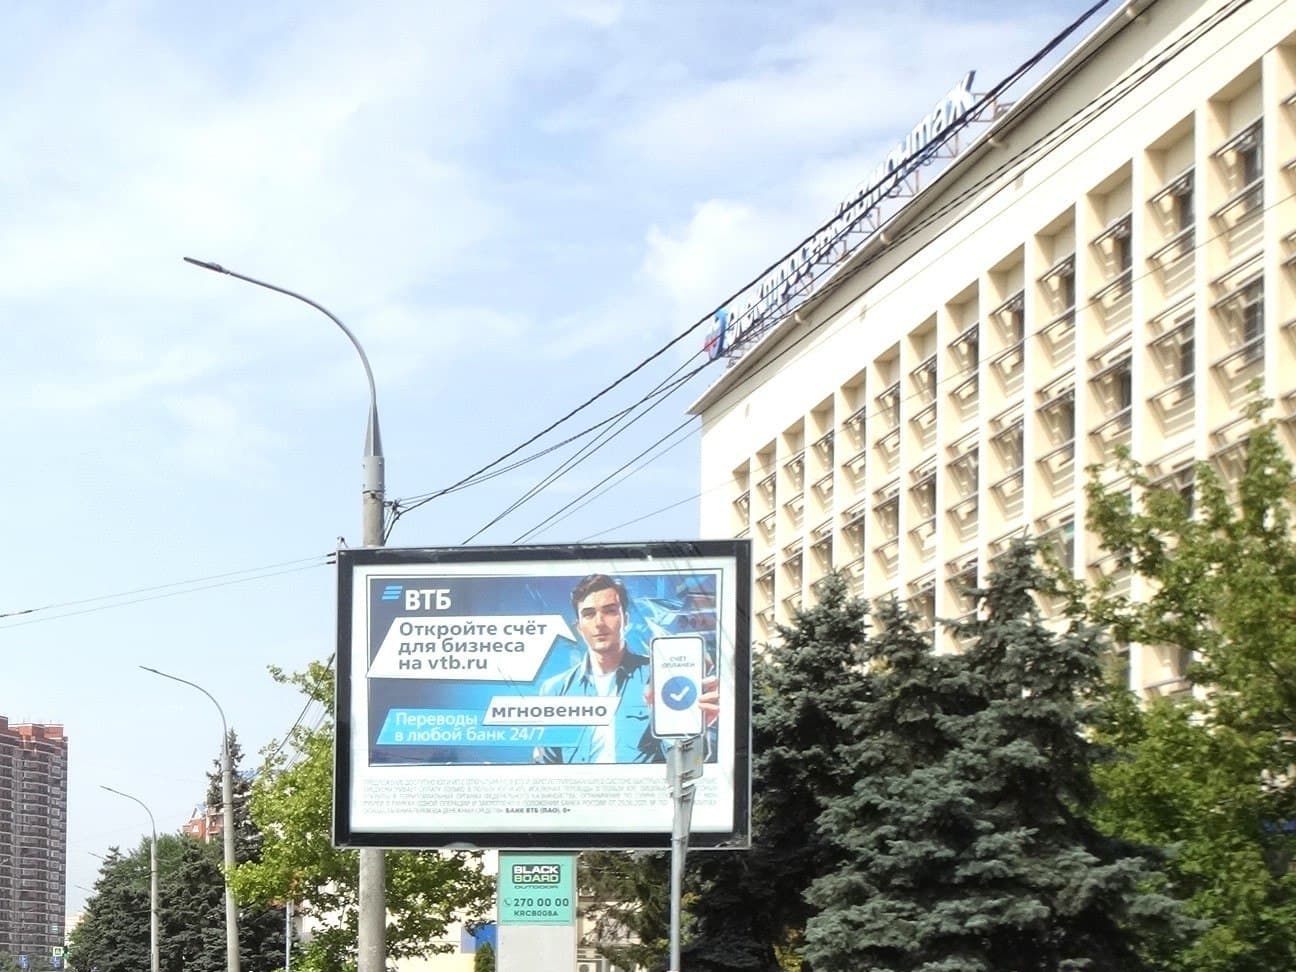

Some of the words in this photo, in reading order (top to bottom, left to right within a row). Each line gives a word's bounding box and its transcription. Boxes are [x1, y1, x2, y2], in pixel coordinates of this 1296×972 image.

[405, 588, 452, 611] ВТБ
[398, 621, 498, 638] Откройте
[503, 622, 547, 636] счёт
[398, 640, 435, 654] для
[442, 638, 525, 654] бизнеса
[398, 657, 422, 670] на
[428, 654, 488, 670] vtb.ru
[396, 712, 478, 728] Переводы
[491, 705, 607, 719] мгновенно
[394, 731, 403, 741] в
[407, 726, 464, 743] любой
[467, 727, 506, 742] банк
[510, 726, 544, 742] 24/7
[514, 866, 558, 874] BLACK
[515, 874, 559, 882] BOARD
[514, 898, 533, 907] 270
[537, 898, 551, 907] 00
[555, 898, 569, 907] 00
